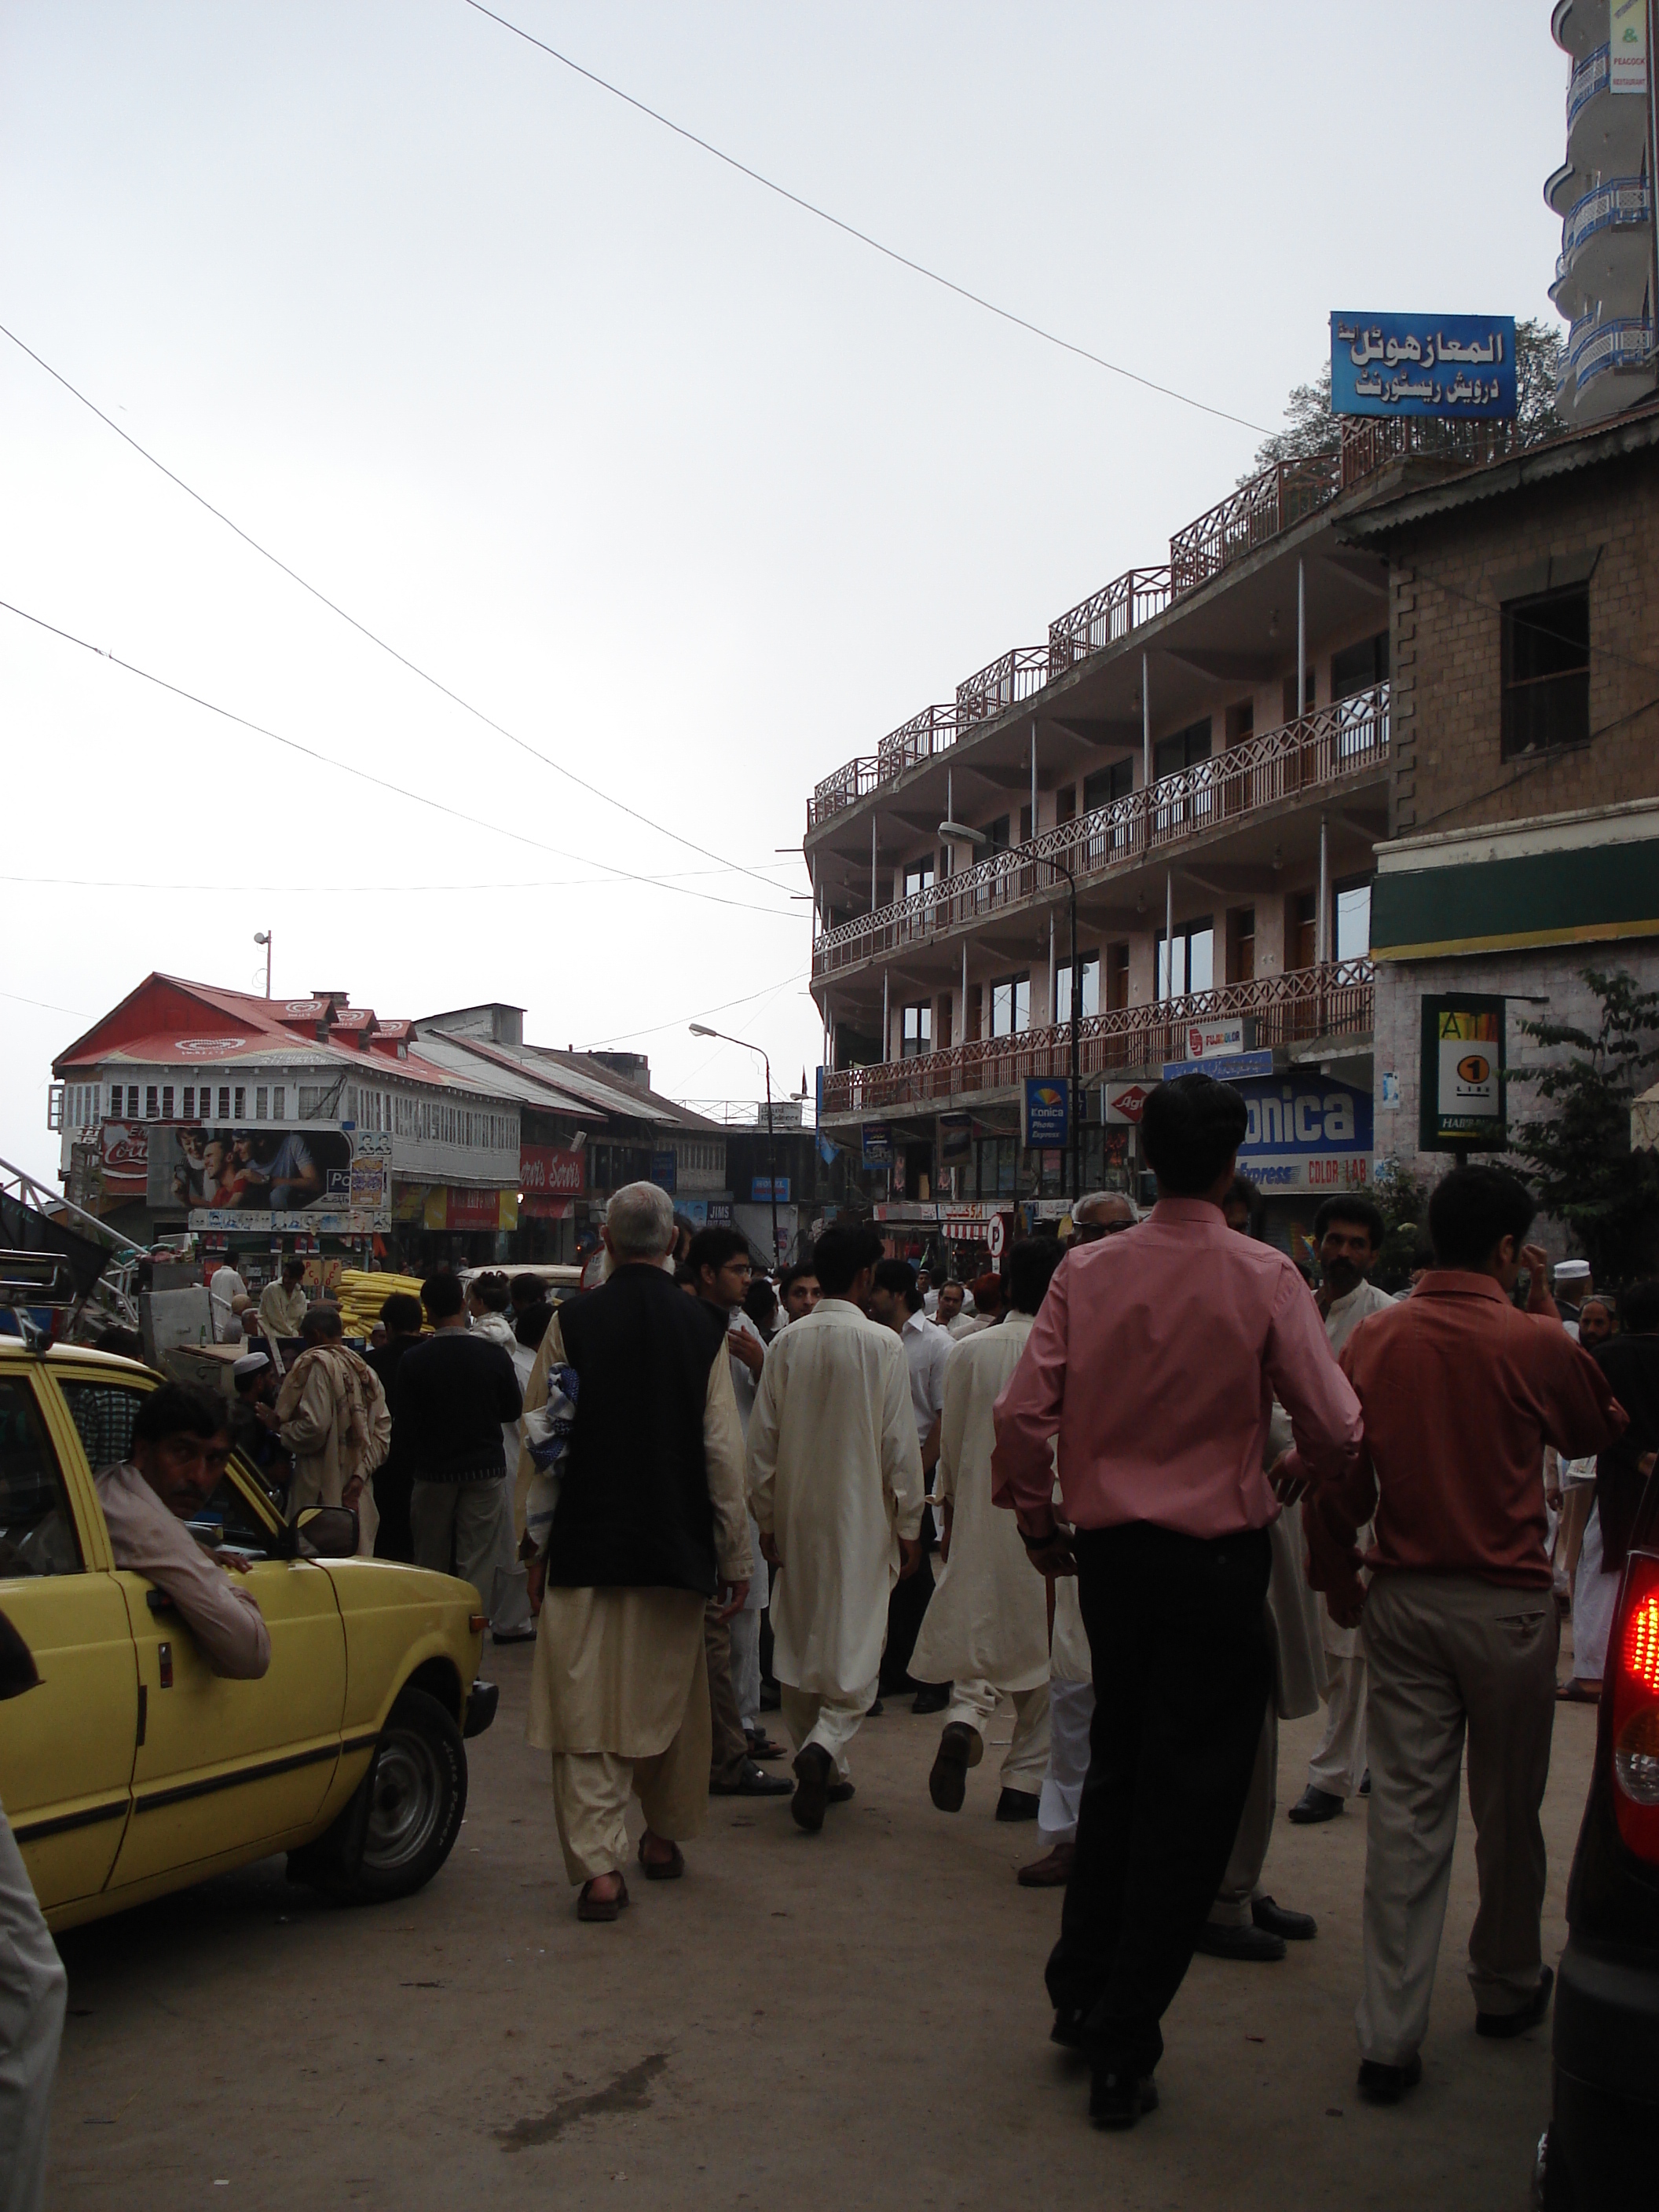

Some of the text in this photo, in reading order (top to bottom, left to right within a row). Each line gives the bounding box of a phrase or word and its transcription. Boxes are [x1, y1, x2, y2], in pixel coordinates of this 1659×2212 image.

[1623, 29, 1638, 43] &
[1206, 1031, 1241, 1046] FUJICOLOR
[1031, 1107, 1064, 1118] Konica
[1240, 1085, 1357, 1145] onica
[1031, 1121, 1055, 1130] Photo
[1031, 1131, 1060, 1140] Express
[521, 1154, 580, 1188] ervis Servis
[1309, 1159, 1339, 1185] COLOR
[1346, 1159, 1368, 1185] LAB
[709, 1206, 730, 1219] JIMS
[439, 1790, 460, 1848] Power
